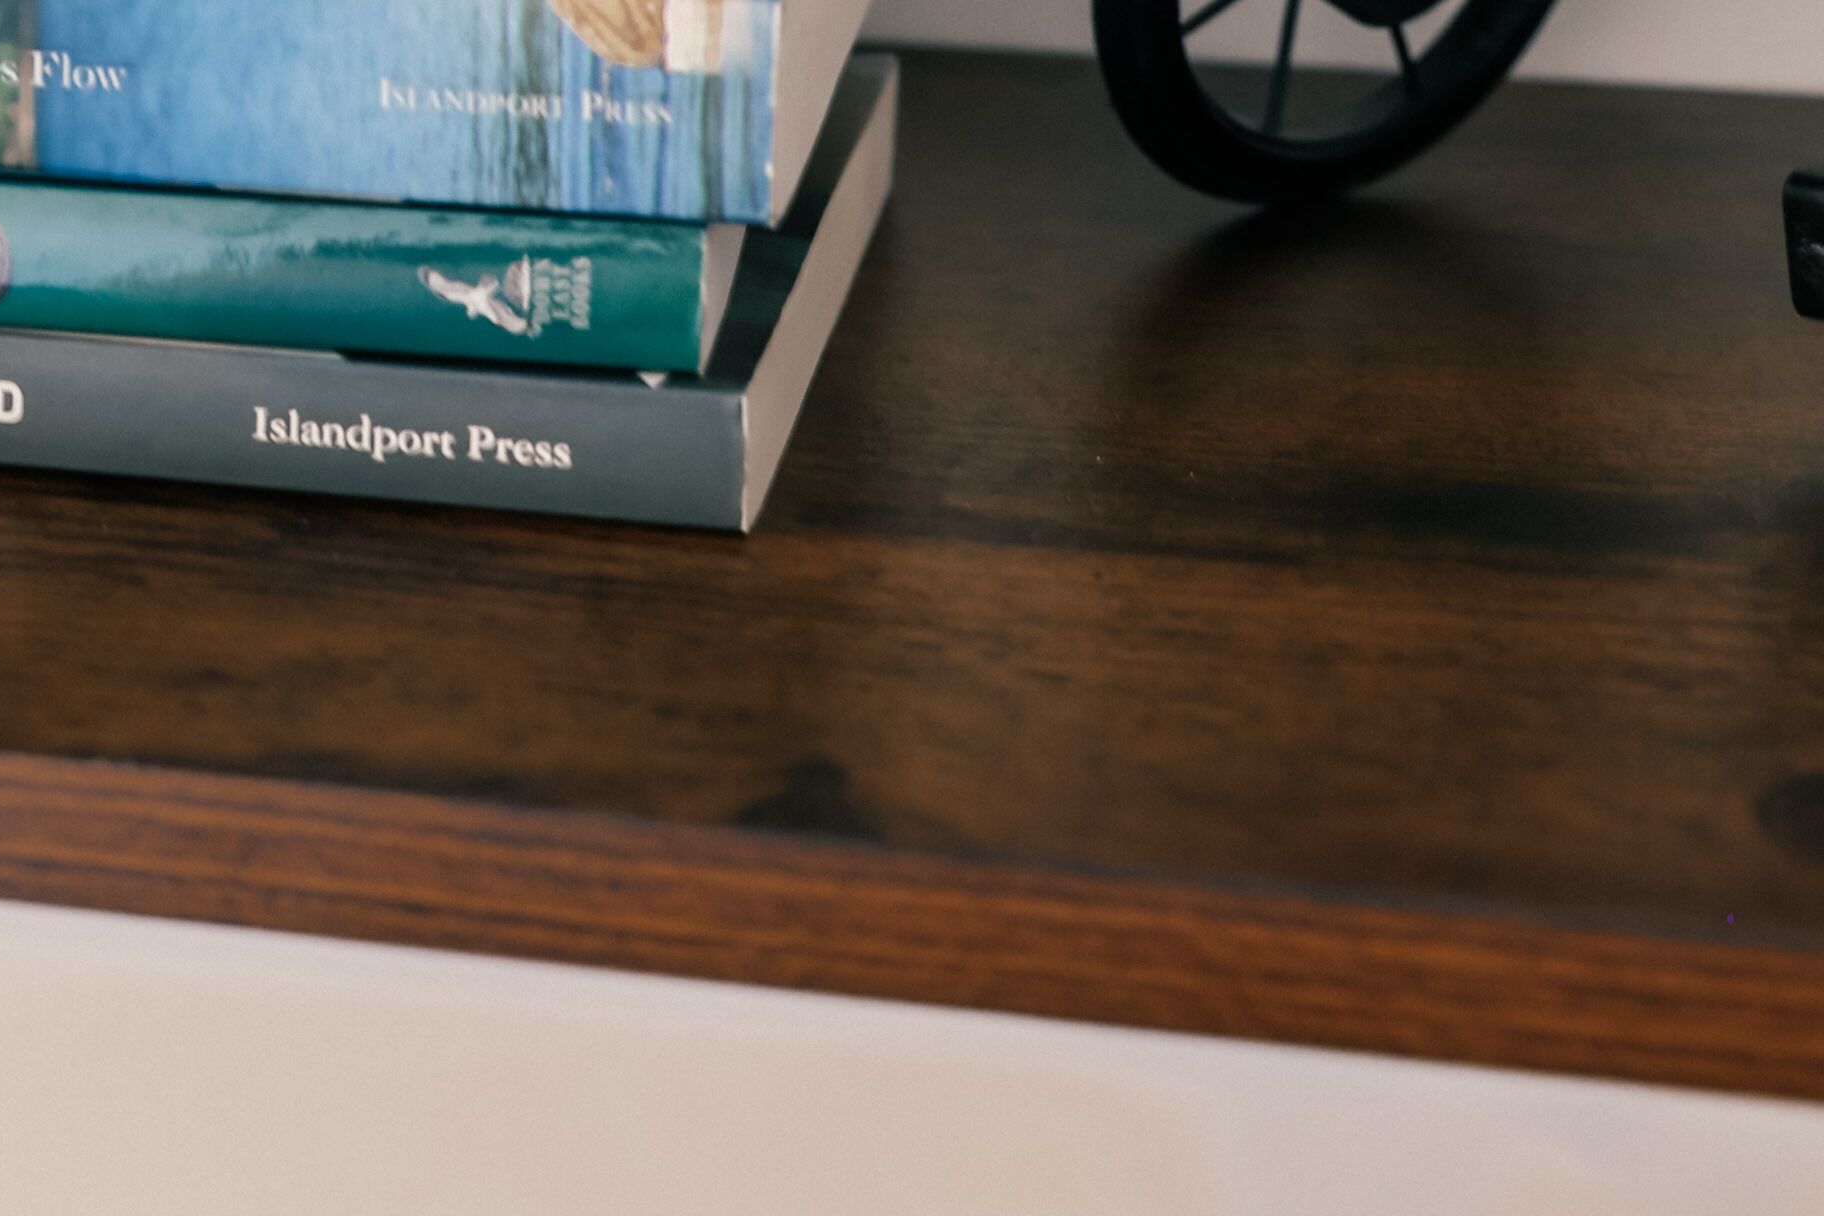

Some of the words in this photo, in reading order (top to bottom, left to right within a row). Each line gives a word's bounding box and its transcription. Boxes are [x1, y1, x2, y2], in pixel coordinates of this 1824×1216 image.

[31, 50, 126, 93] Flow
[253, 406, 456, 463] Islandport
[466, 424, 573, 470] Press
